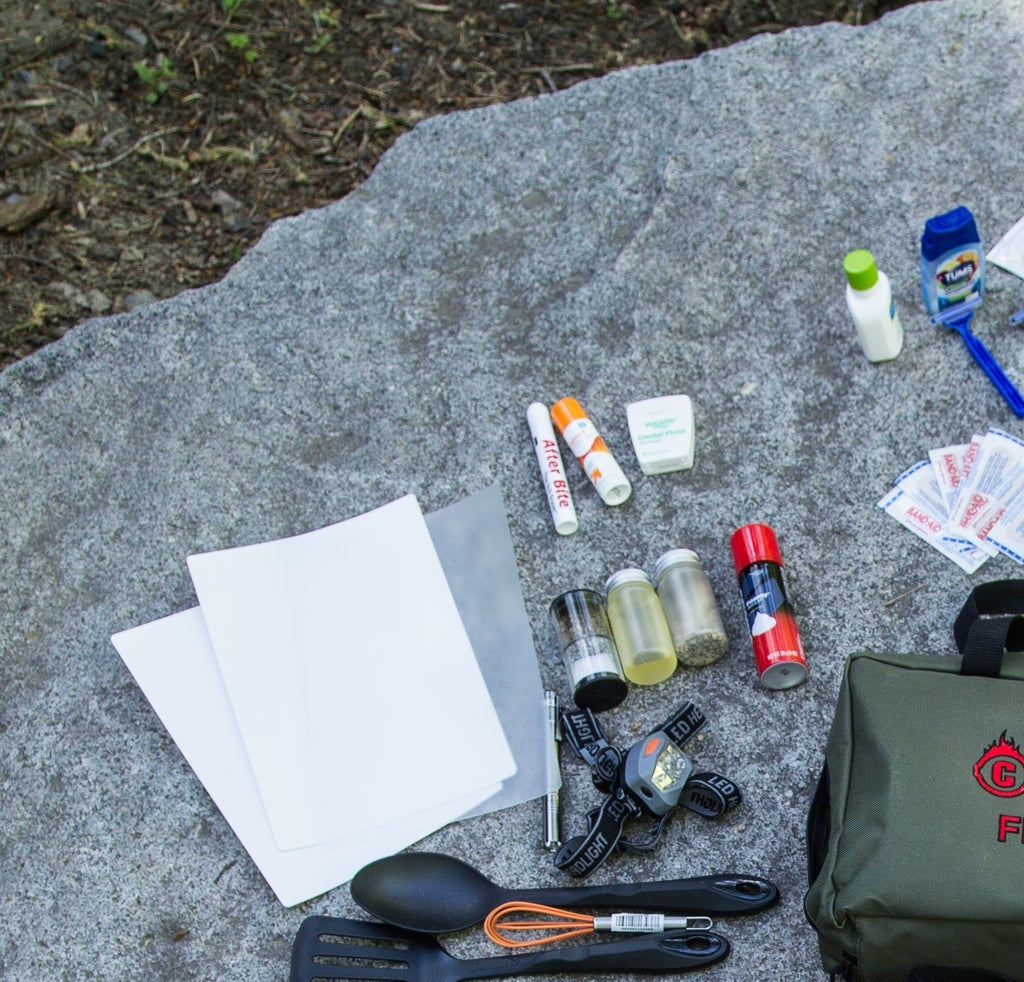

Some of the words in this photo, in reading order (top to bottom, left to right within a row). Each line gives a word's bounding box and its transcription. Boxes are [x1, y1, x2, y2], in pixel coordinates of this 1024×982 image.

[944, 263, 973, 284] TUMS
[541, 439, 561, 475] After
[553, 479, 570, 508] Bite
[907, 506, 942, 533] BAND-AID
[707, 775, 735, 797] LED
